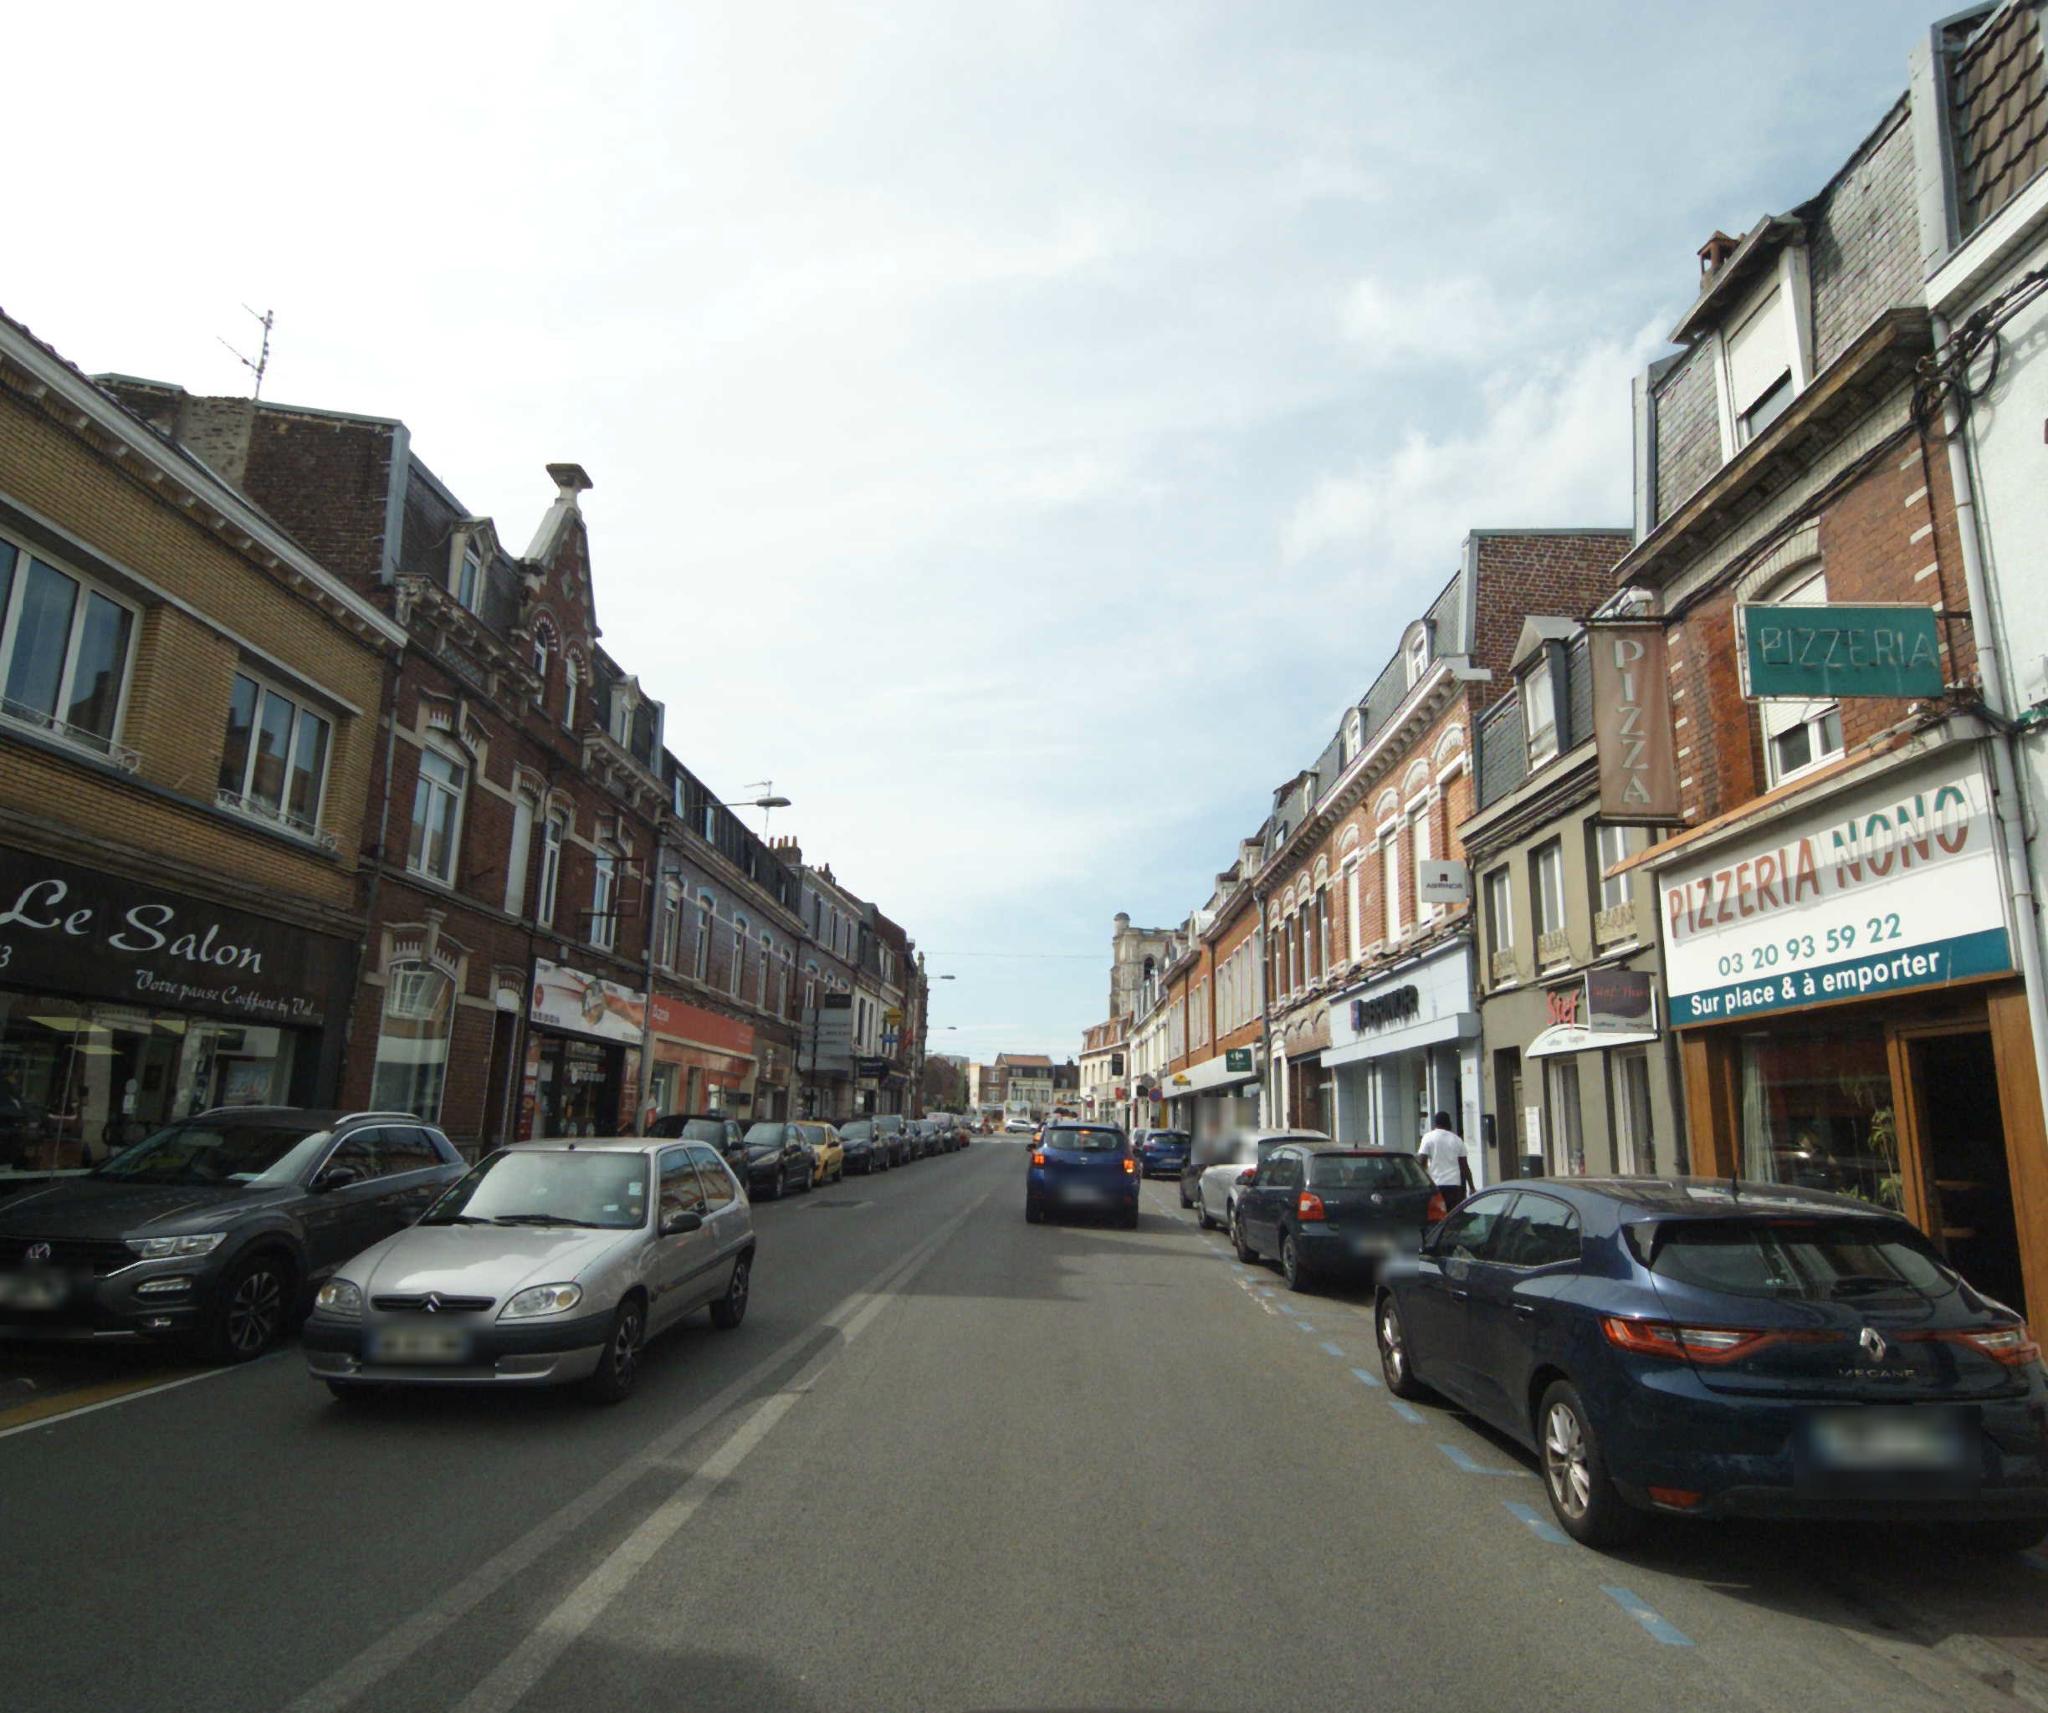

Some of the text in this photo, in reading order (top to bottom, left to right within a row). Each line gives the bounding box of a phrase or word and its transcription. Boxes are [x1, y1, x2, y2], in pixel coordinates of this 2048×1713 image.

[1759, 626, 1938, 668] PIZZERIA
[1613, 638, 1651, 804] PIZZA
[1667, 785, 1970, 939] PIZZERIA NONO
[0, 879, 262, 974] Le Salon
[1718, 913, 1903, 977] 03 20 93 59 22
[1691, 952, 1940, 1016] Sur place & à emporter
